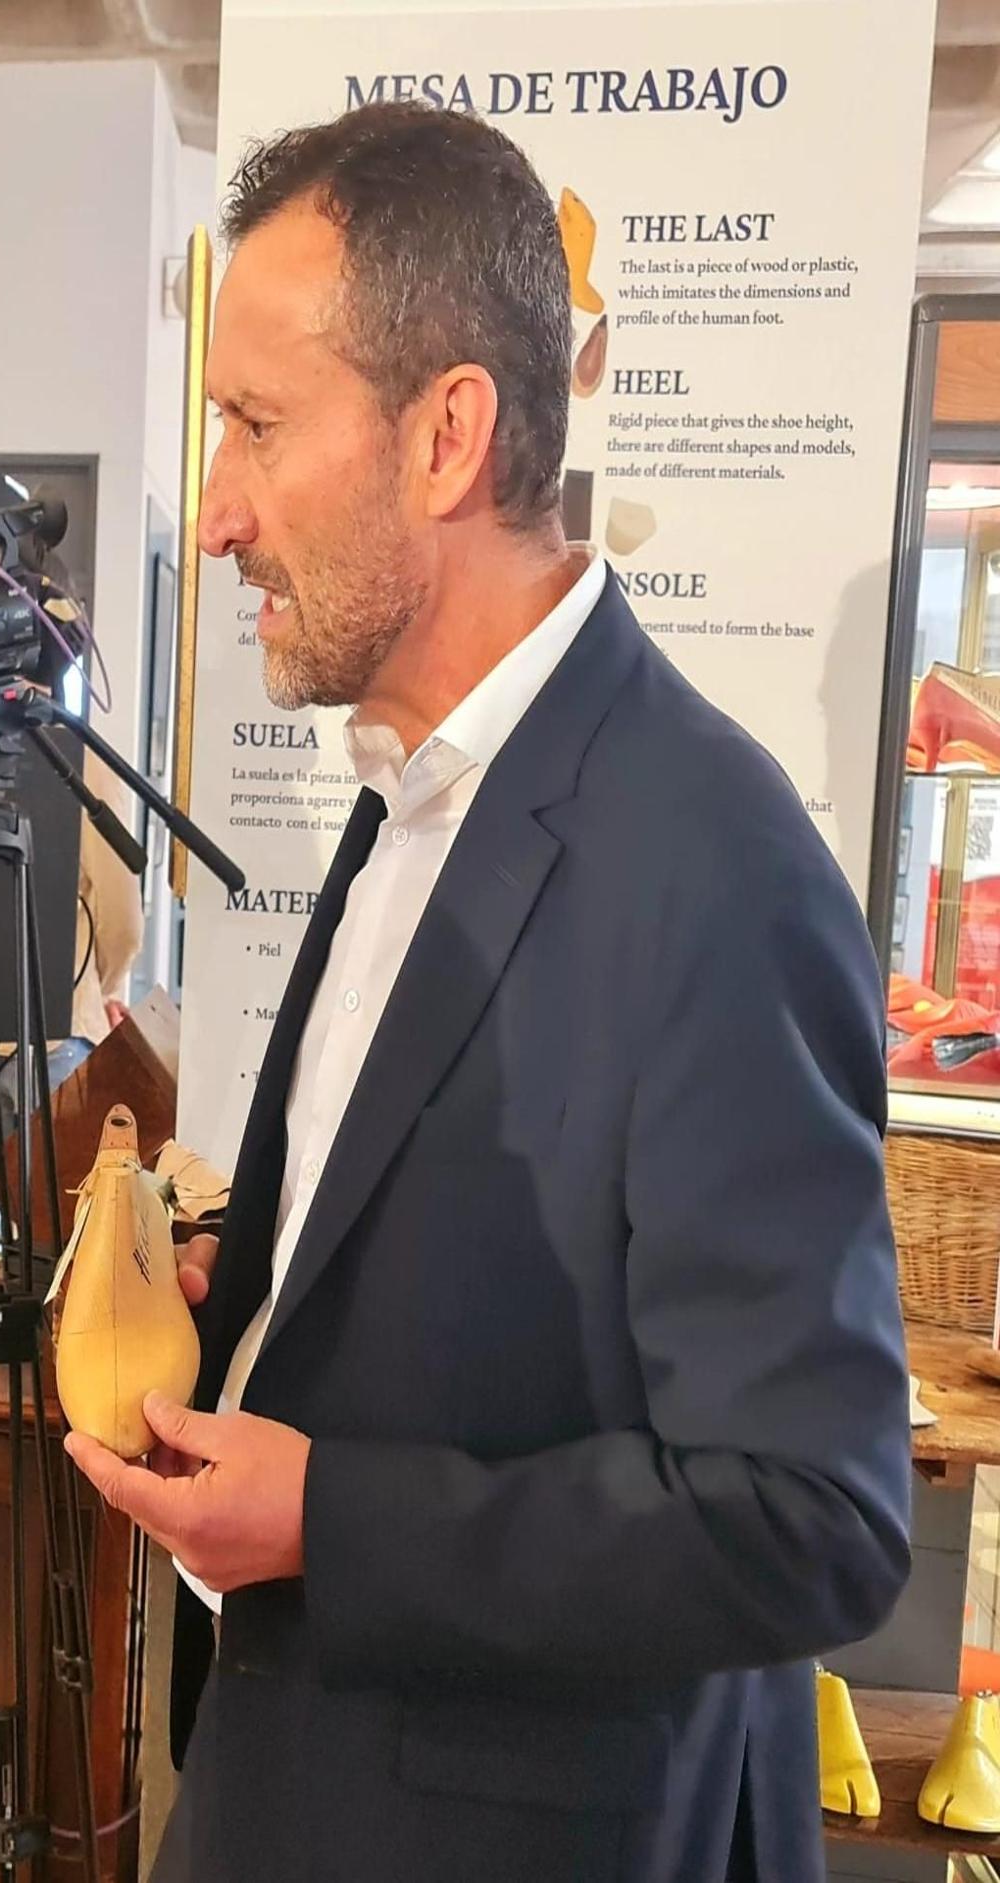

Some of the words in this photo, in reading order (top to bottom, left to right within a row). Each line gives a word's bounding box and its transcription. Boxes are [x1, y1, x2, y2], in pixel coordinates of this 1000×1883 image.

[488, 72, 555, 114] DE
[565, 65, 788, 123] TRABAJO
[622, 215, 687, 242] THE
[694, 213, 775, 242] LAST
[619, 259, 645, 274] The
[648, 259, 671, 274] last
[674, 259, 685, 273] is
[687, 263, 694, 273] a
[697, 259, 731, 277] piece
[735, 258, 750, 272] of
[751, 257, 789, 272] wood
[791, 261, 806, 272] or
[809, 256, 859, 275] plastic,
[619, 285, 660, 299] which
[662, 284, 716, 299] imitates
[718, 284, 741, 299] the
[743, 283, 822, 298] dimensions
[824, 283, 850, 298] and
[616, 310, 660, 328] profile
[662, 310, 677, 325] of
[678, 310, 700, 325] the
[702, 310, 750, 325] human
[752, 309, 784, 325] foot.
[612, 369, 690, 395] HEEL
[608, 413, 642, 431] Rigid
[645, 413, 679, 431] piece
[681, 414, 709, 429] that
[711, 414, 744, 432] gives
[747, 414, 769, 429] the
[771, 414, 801, 429] shoe
[805, 414, 854, 432] height,
[607, 438, 641, 452] there
[644, 442, 664, 452] are
[667, 438, 725, 453] different
[727, 440, 771, 457] shapes
[774, 440, 799, 454] and
[802, 440, 856, 457] models,
[605, 463, 641, 478] made
[644, 463, 658, 478] of
[659, 464, 716, 478] different
[718, 465, 785, 480] materials.
[615, 571, 707, 598] NSOLE
[677, 620, 707, 634] used
[709, 622, 723, 634] to
[725, 621, 758, 636] form
[761, 622, 782, 636] the
[784, 622, 815, 637] base
[238, 632, 256, 645] del
[233, 722, 320, 749] SUELA
[232, 767, 246, 779] La
[249, 768, 279, 780] suela
[282, 771, 294, 780] es
[297, 768, 307, 782] la
[310, 770, 342, 786] pieza
[230, 792, 304, 807] proporciona
[307, 796, 346, 811] agarre
[230, 816, 282, 828] contacto
[286, 818, 308, 829] con
[311, 817, 322, 830] el
[324, 819, 348, 831] sue
[258, 943, 281, 957] Piel
